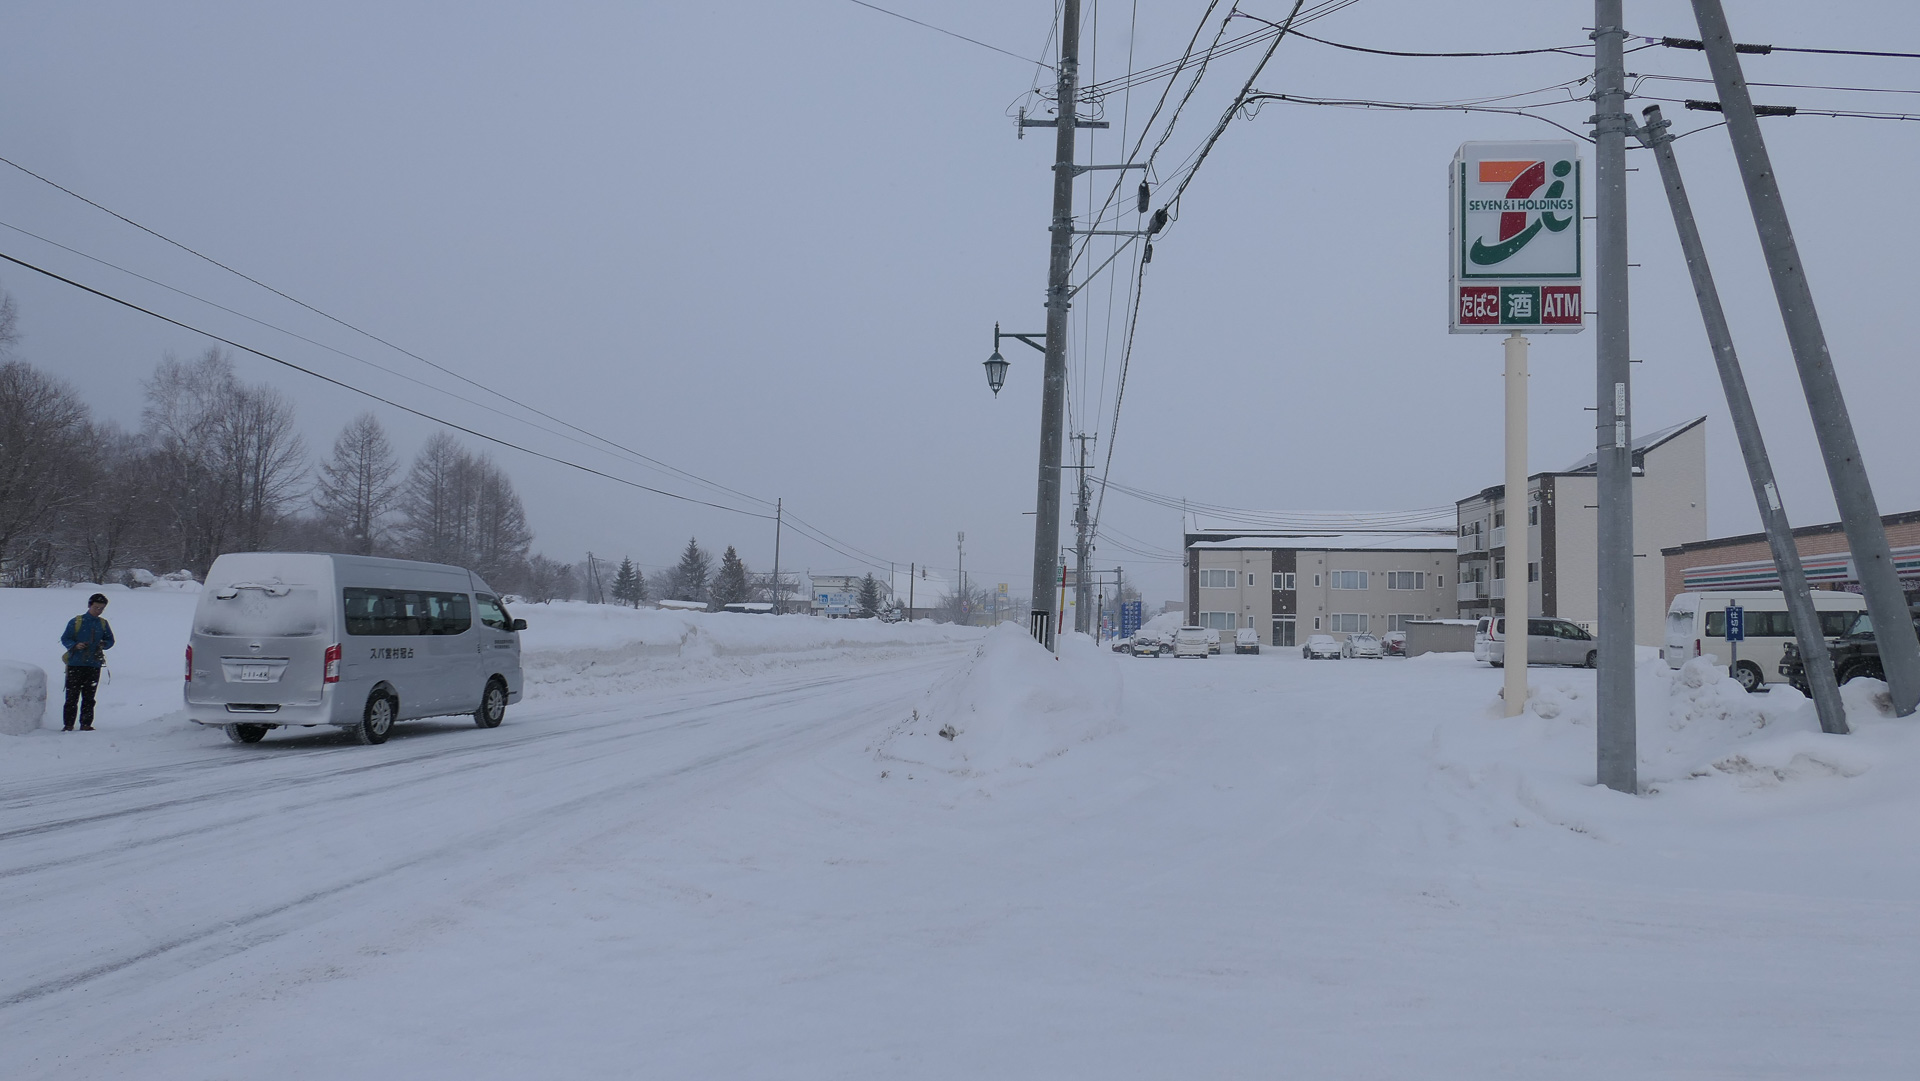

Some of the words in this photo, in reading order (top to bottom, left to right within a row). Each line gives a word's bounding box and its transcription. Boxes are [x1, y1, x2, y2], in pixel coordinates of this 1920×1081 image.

[1517, 199, 1574, 210] HOLDINGS
[1461, 293, 1498, 317] たばこ
[1508, 293, 1532, 318] 酒
[1543, 293, 1579, 317] ATM
[1730, 611, 1739, 635] 仕切弁
